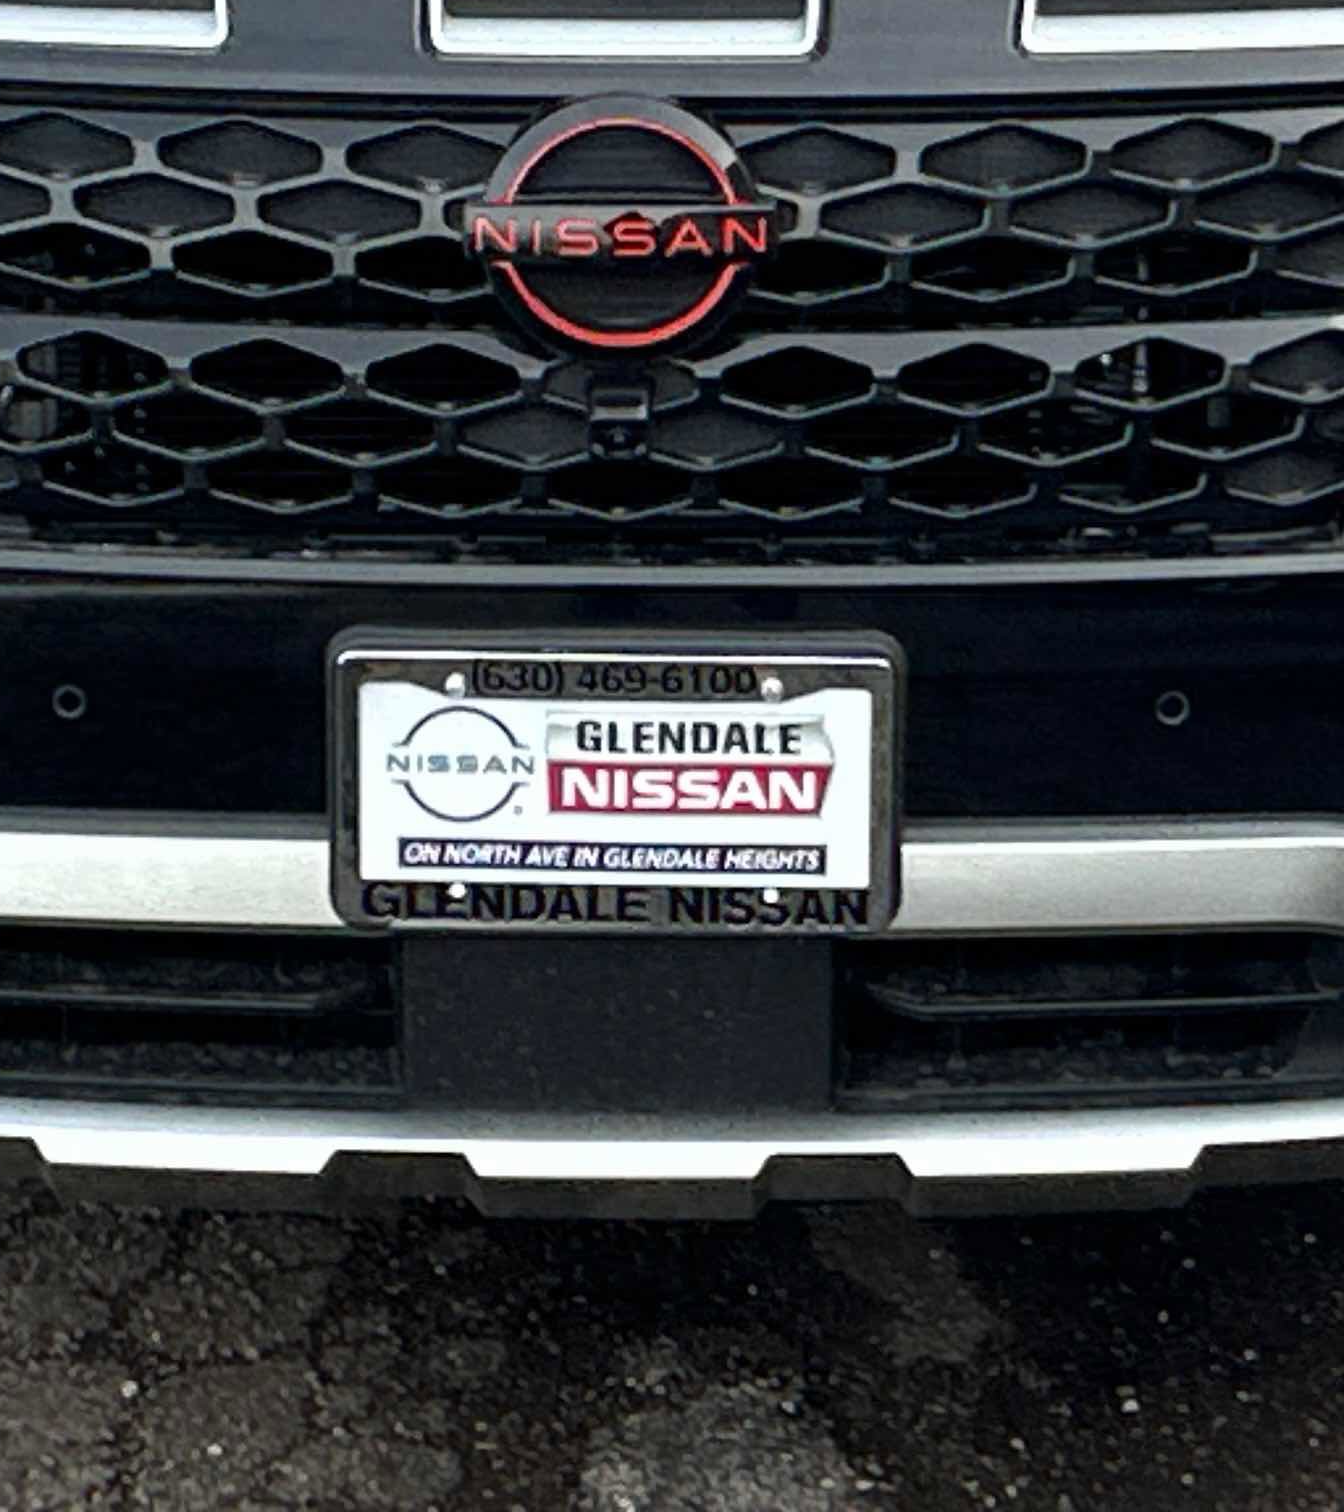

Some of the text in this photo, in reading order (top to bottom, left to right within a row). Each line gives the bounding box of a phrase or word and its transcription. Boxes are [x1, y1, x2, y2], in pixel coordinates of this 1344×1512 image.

[472, 216, 767, 257] NISSAN
[471, 659, 758, 696] (630) 469-6100
[575, 719, 802, 756] GLENDALE
[386, 752, 535, 776] NISSAN
[560, 767, 817, 812] NISSAN
[404, 842, 821, 872] ON NORTH AVE IN GLENDALE HEIGHTS
[361, 882, 870, 926] GLENDALE NISSAN
